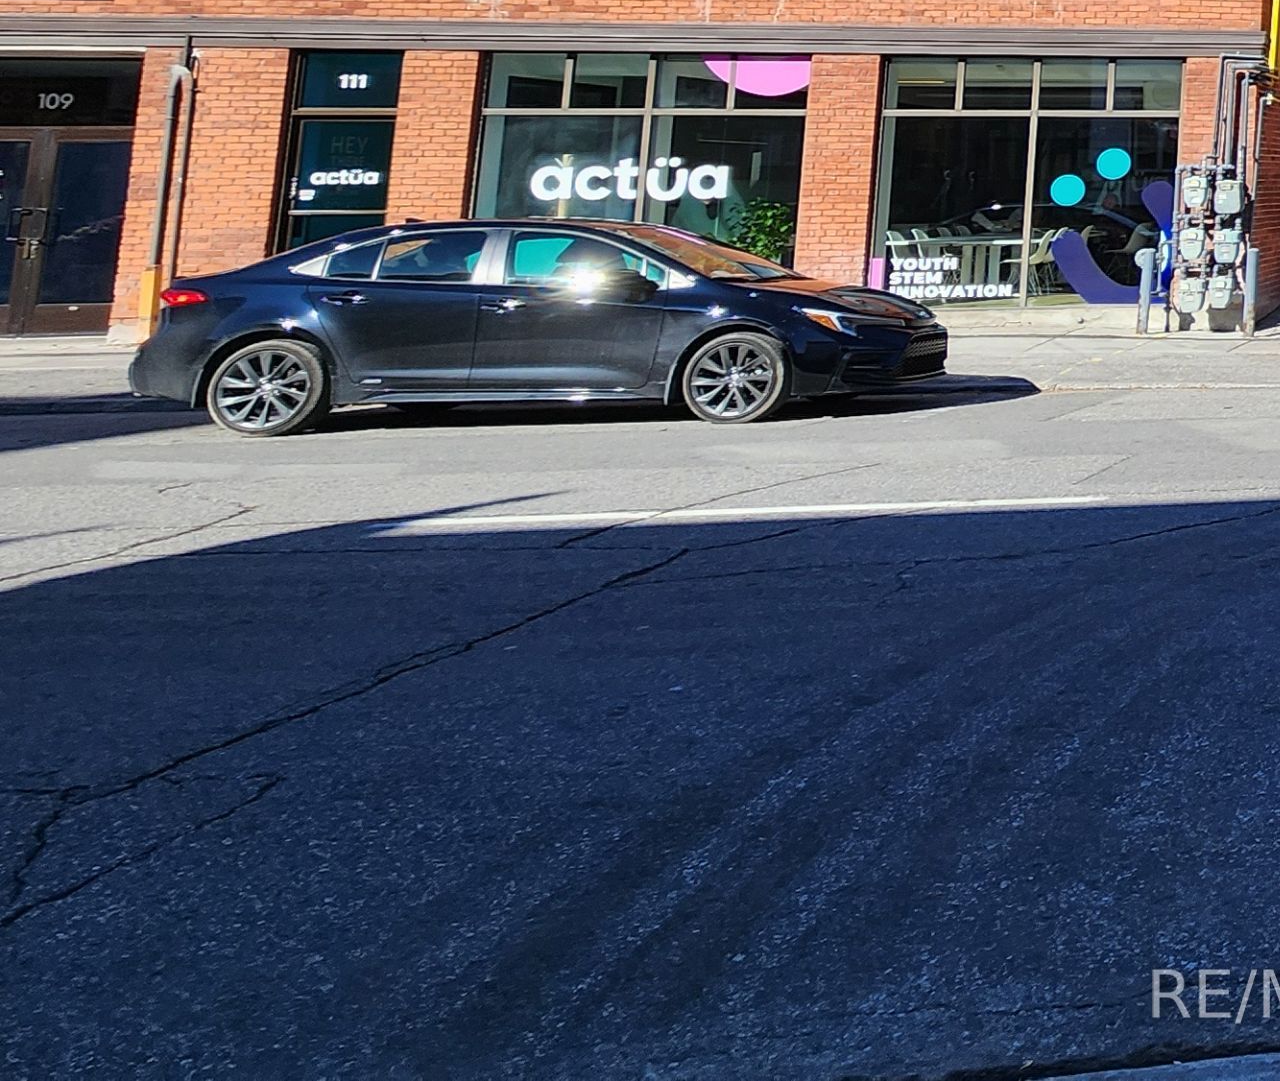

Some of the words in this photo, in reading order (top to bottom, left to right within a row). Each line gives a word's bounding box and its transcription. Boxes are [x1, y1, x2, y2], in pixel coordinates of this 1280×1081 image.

[338, 73, 368, 89] 111
[38, 92, 74, 110] 109
[309, 168, 380, 185] actüa
[530, 156, 730, 202] actüa
[890, 257, 960, 271] YOUTH
[889, 271, 944, 285] STEM
